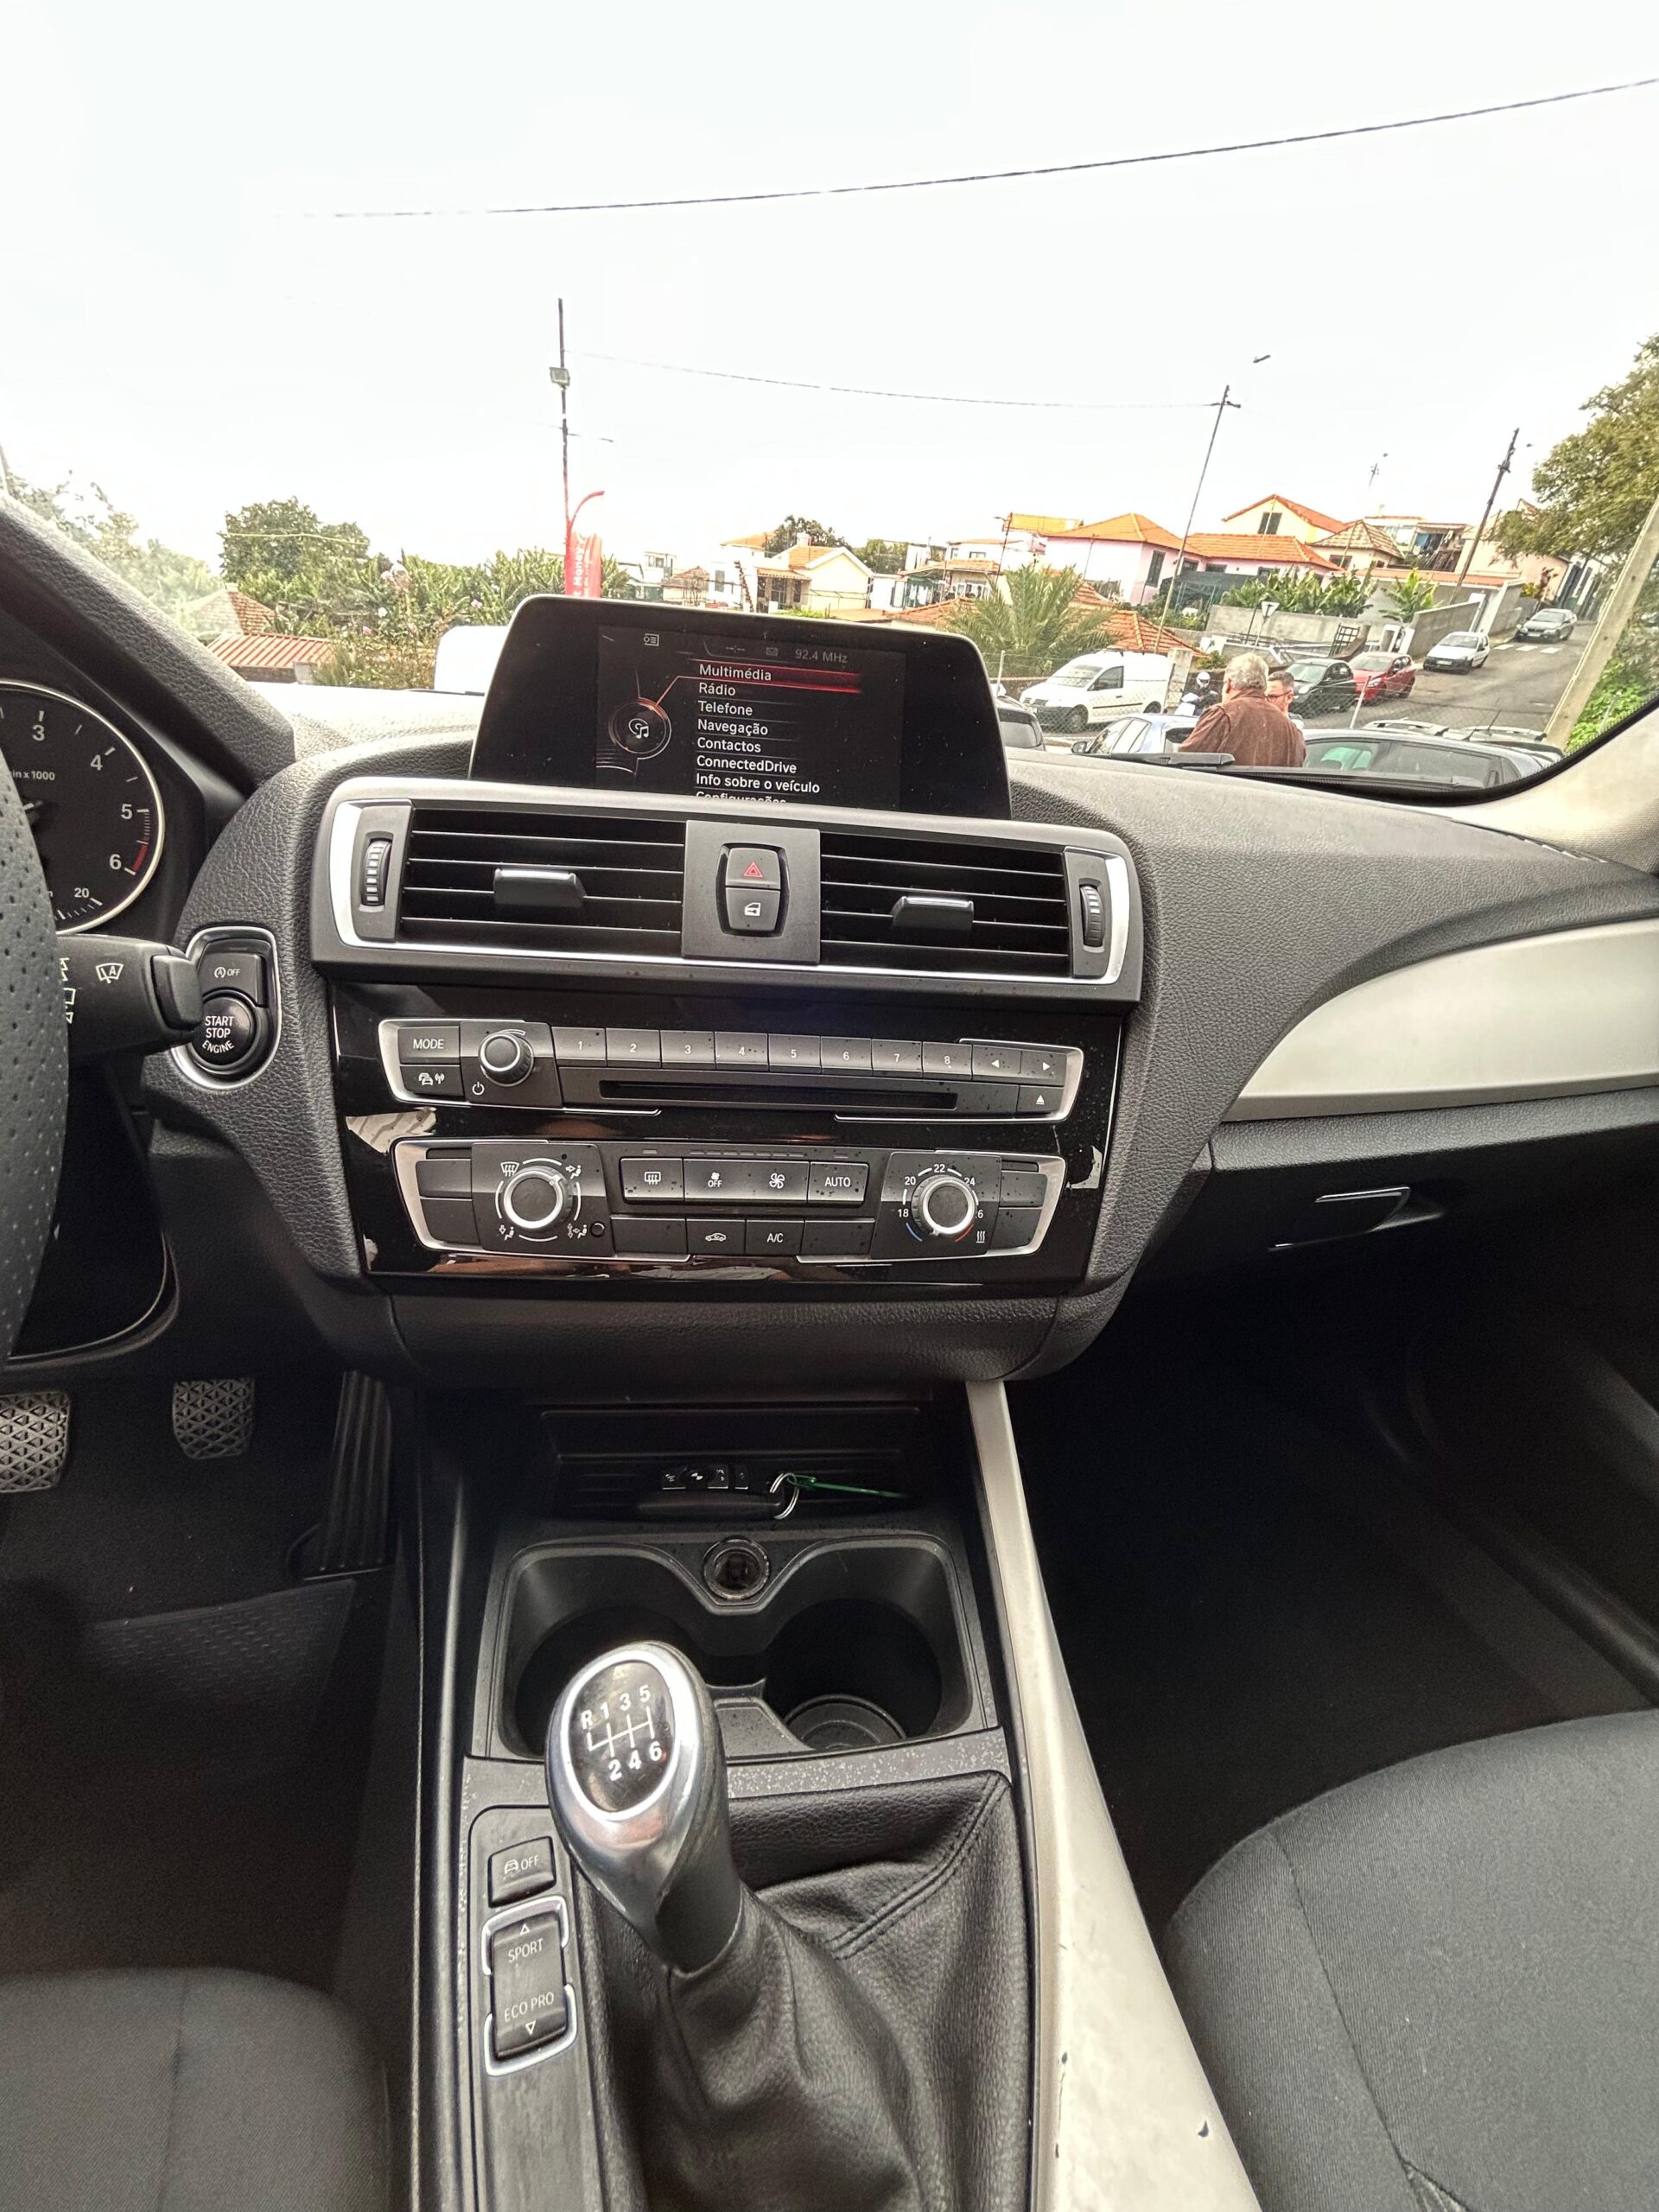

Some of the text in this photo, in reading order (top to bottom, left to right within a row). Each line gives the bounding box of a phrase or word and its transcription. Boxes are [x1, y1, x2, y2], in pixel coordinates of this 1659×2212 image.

[795, 649, 848, 664] 92.4 MHz
[699, 664, 772, 681] Multimédia
[698, 682, 736, 696] Rádio
[697, 700, 753, 716] Telefone
[32, 724, 45, 741] 3
[697, 718, 768, 737] Navegação
[697, 736, 762, 753] Contactos
[90, 754, 103, 771] 4
[696, 754, 798, 774] ConnectedDrive
[31, 770, 56, 781] 1000
[696, 773, 821, 793] Info sobre o veículo
[120, 803, 133, 820] 5
[109, 854, 123, 870] 6
[73, 887, 90, 899] 20
[205, 1015, 235, 1027] START
[206, 1027, 231, 1039] STOP
[201, 1039, 235, 1053] ENGINE
[412, 1039, 444, 1050] MODE
[577, 1040, 583, 1051] 1
[629, 1043, 637, 1053] 2
[683, 1044, 692, 1054] 3
[738, 1046, 746, 1056] 4
[790, 1049, 798, 1059] 5
[842, 1051, 850, 1061] 6
[893, 1052, 901, 1063] 7
[944, 1055, 951, 1065] 8
[933, 1163, 945, 1173] 22
[707, 1179, 723, 1188] OFF
[824, 1176, 852, 1187] AUTO
[904, 1176, 917, 1186] 20
[897, 1208, 910, 1218] 18
[766, 1232, 785, 1243] A/C
[581, 1684, 652, 1730] R 1 3 5
[607, 1740, 663, 1782] 2 4 6
[520, 1854, 540, 1872] OFF
[507, 1937, 544, 1963] SPORT
[504, 1991, 555, 2023] ECO PRO
